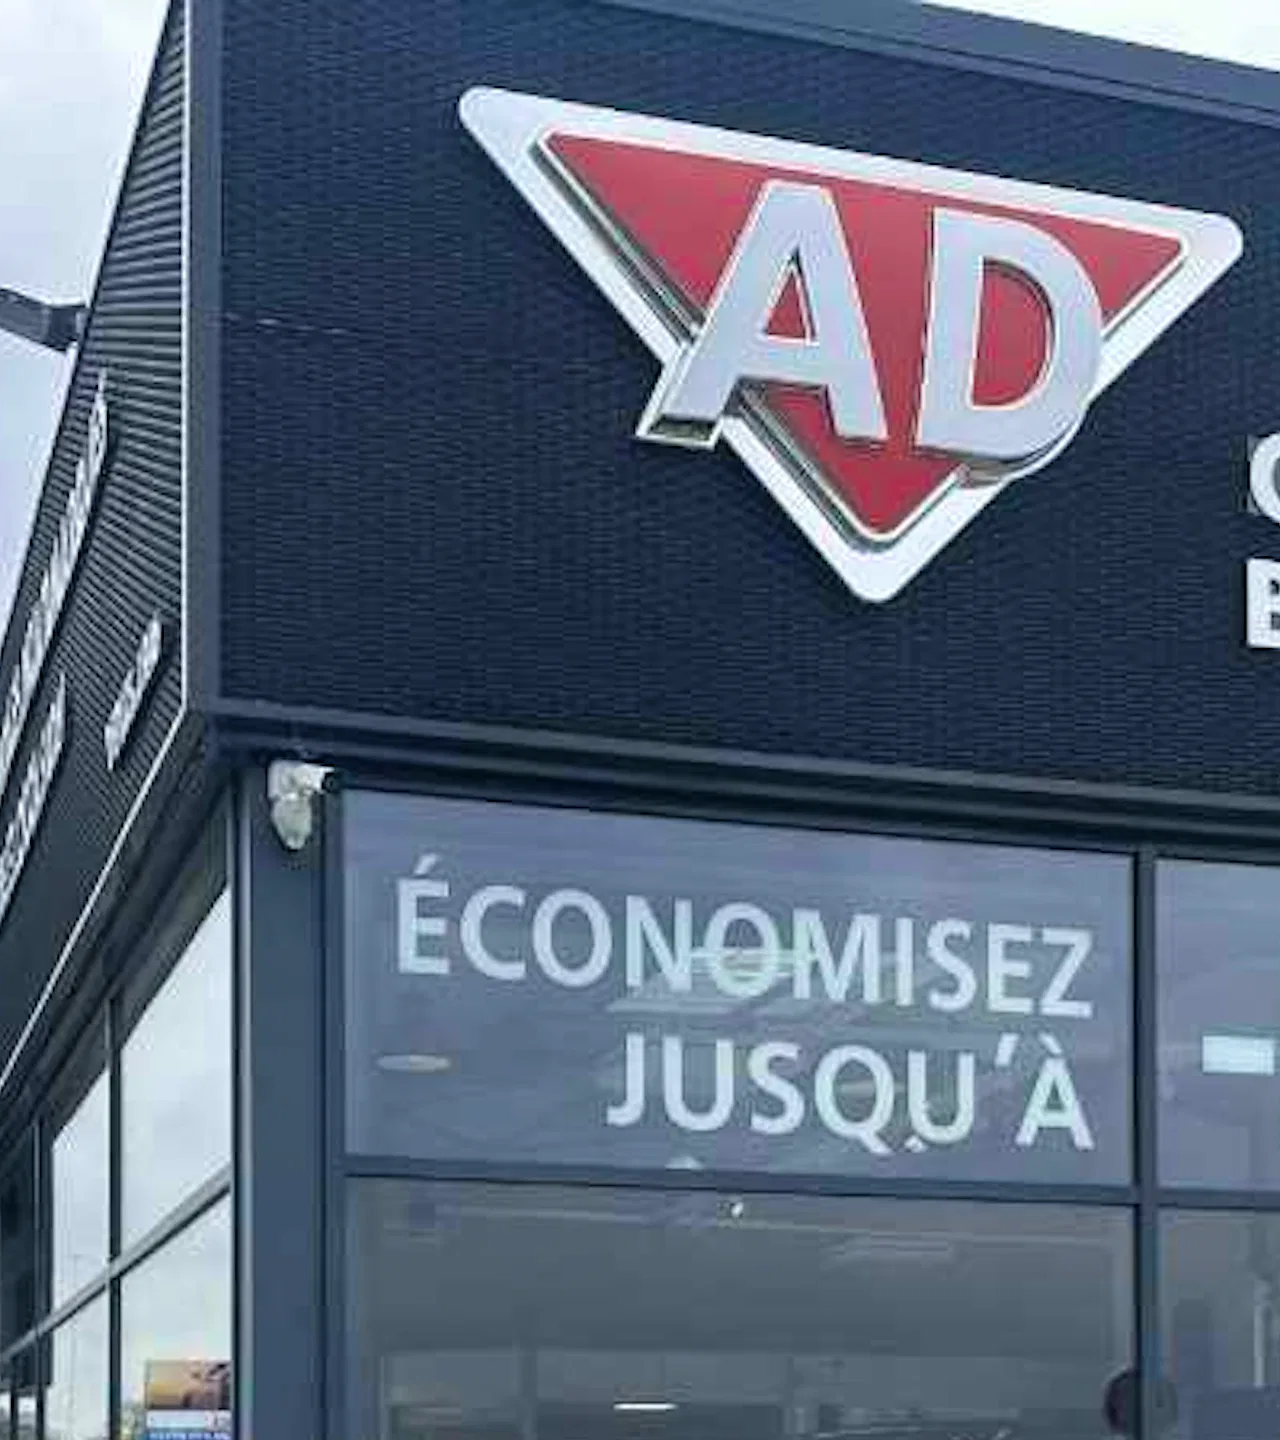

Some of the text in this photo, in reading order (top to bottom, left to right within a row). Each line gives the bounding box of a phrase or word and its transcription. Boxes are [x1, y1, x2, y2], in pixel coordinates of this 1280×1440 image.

[644, 178, 1104, 462] AD
[395, 853, 1094, 1019] ÉCONOMISEZ
[605, 1031, 1097, 1156] JUSQU'À
